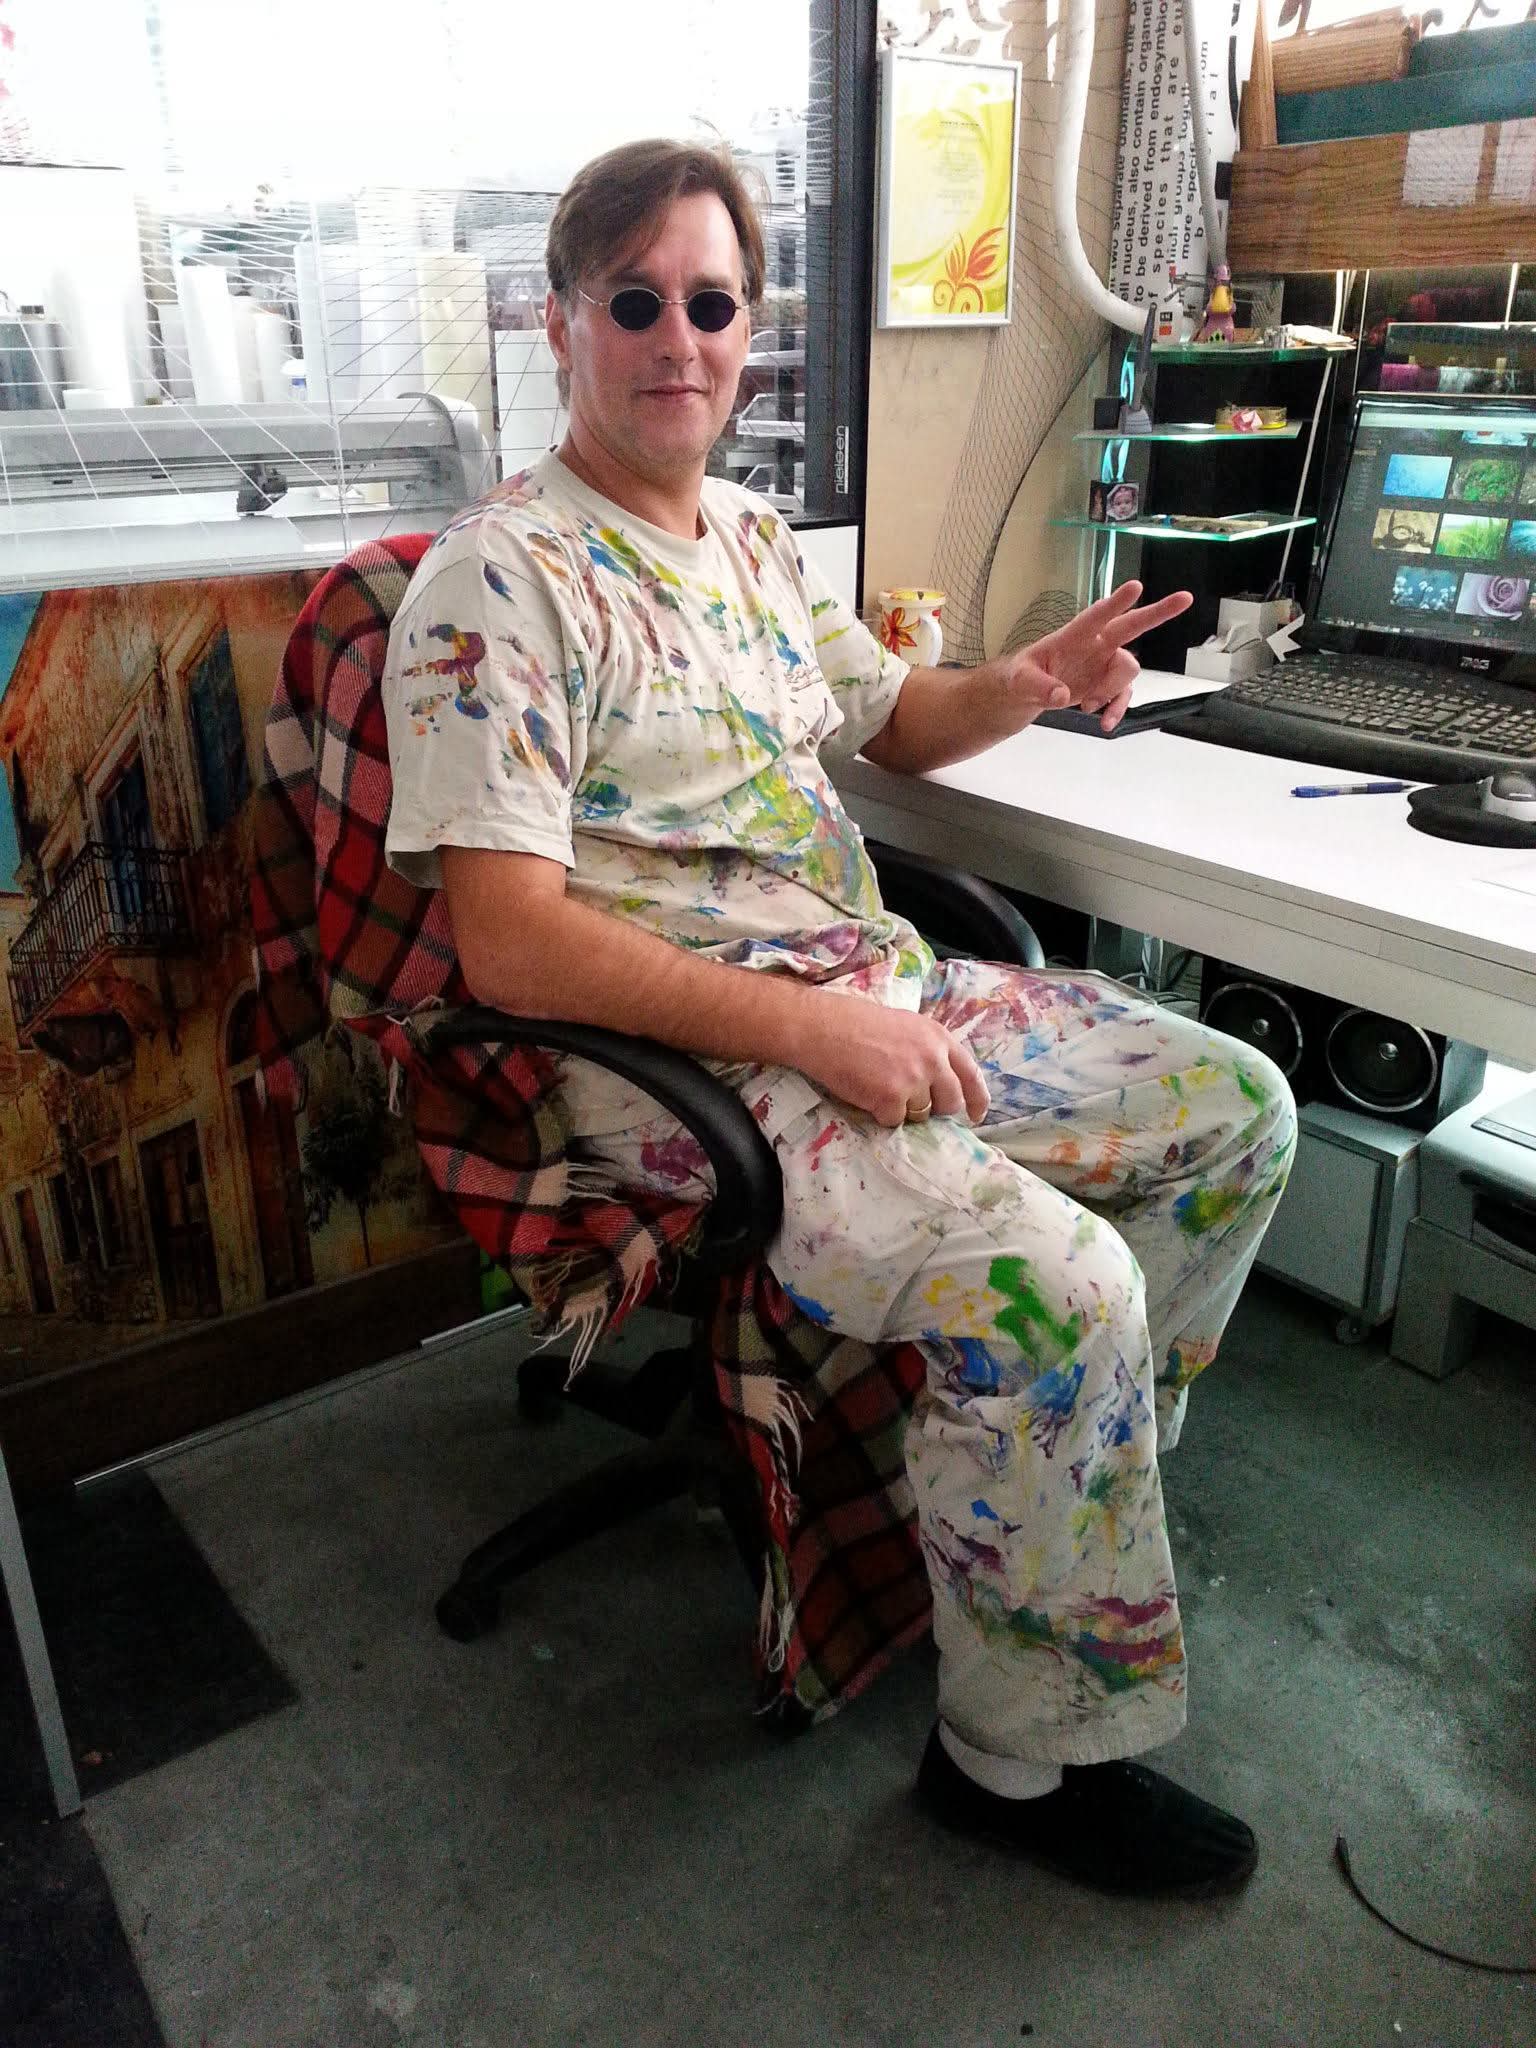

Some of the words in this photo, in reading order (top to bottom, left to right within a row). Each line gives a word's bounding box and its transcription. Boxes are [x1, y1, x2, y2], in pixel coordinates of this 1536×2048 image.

[1139, 0, 1153, 73] organel
[1173, 0, 1184, 36] eu
[1151, 0, 1168, 121] endosymbio
[1168, 56, 1179, 95] are
[1133, 80, 1146, 149] contain
[1144, 129, 1157, 172] from
[1160, 114, 1174, 163] that
[1128, 156, 1140, 193] also
[1138, 181, 1153, 247] derived
[1153, 182, 1168, 273] species
[1181, 214, 1193, 260] more
[1123, 202, 1139, 275] nucleus,
[1135, 255, 1147, 277] be
[1134, 285, 1144, 302] to
